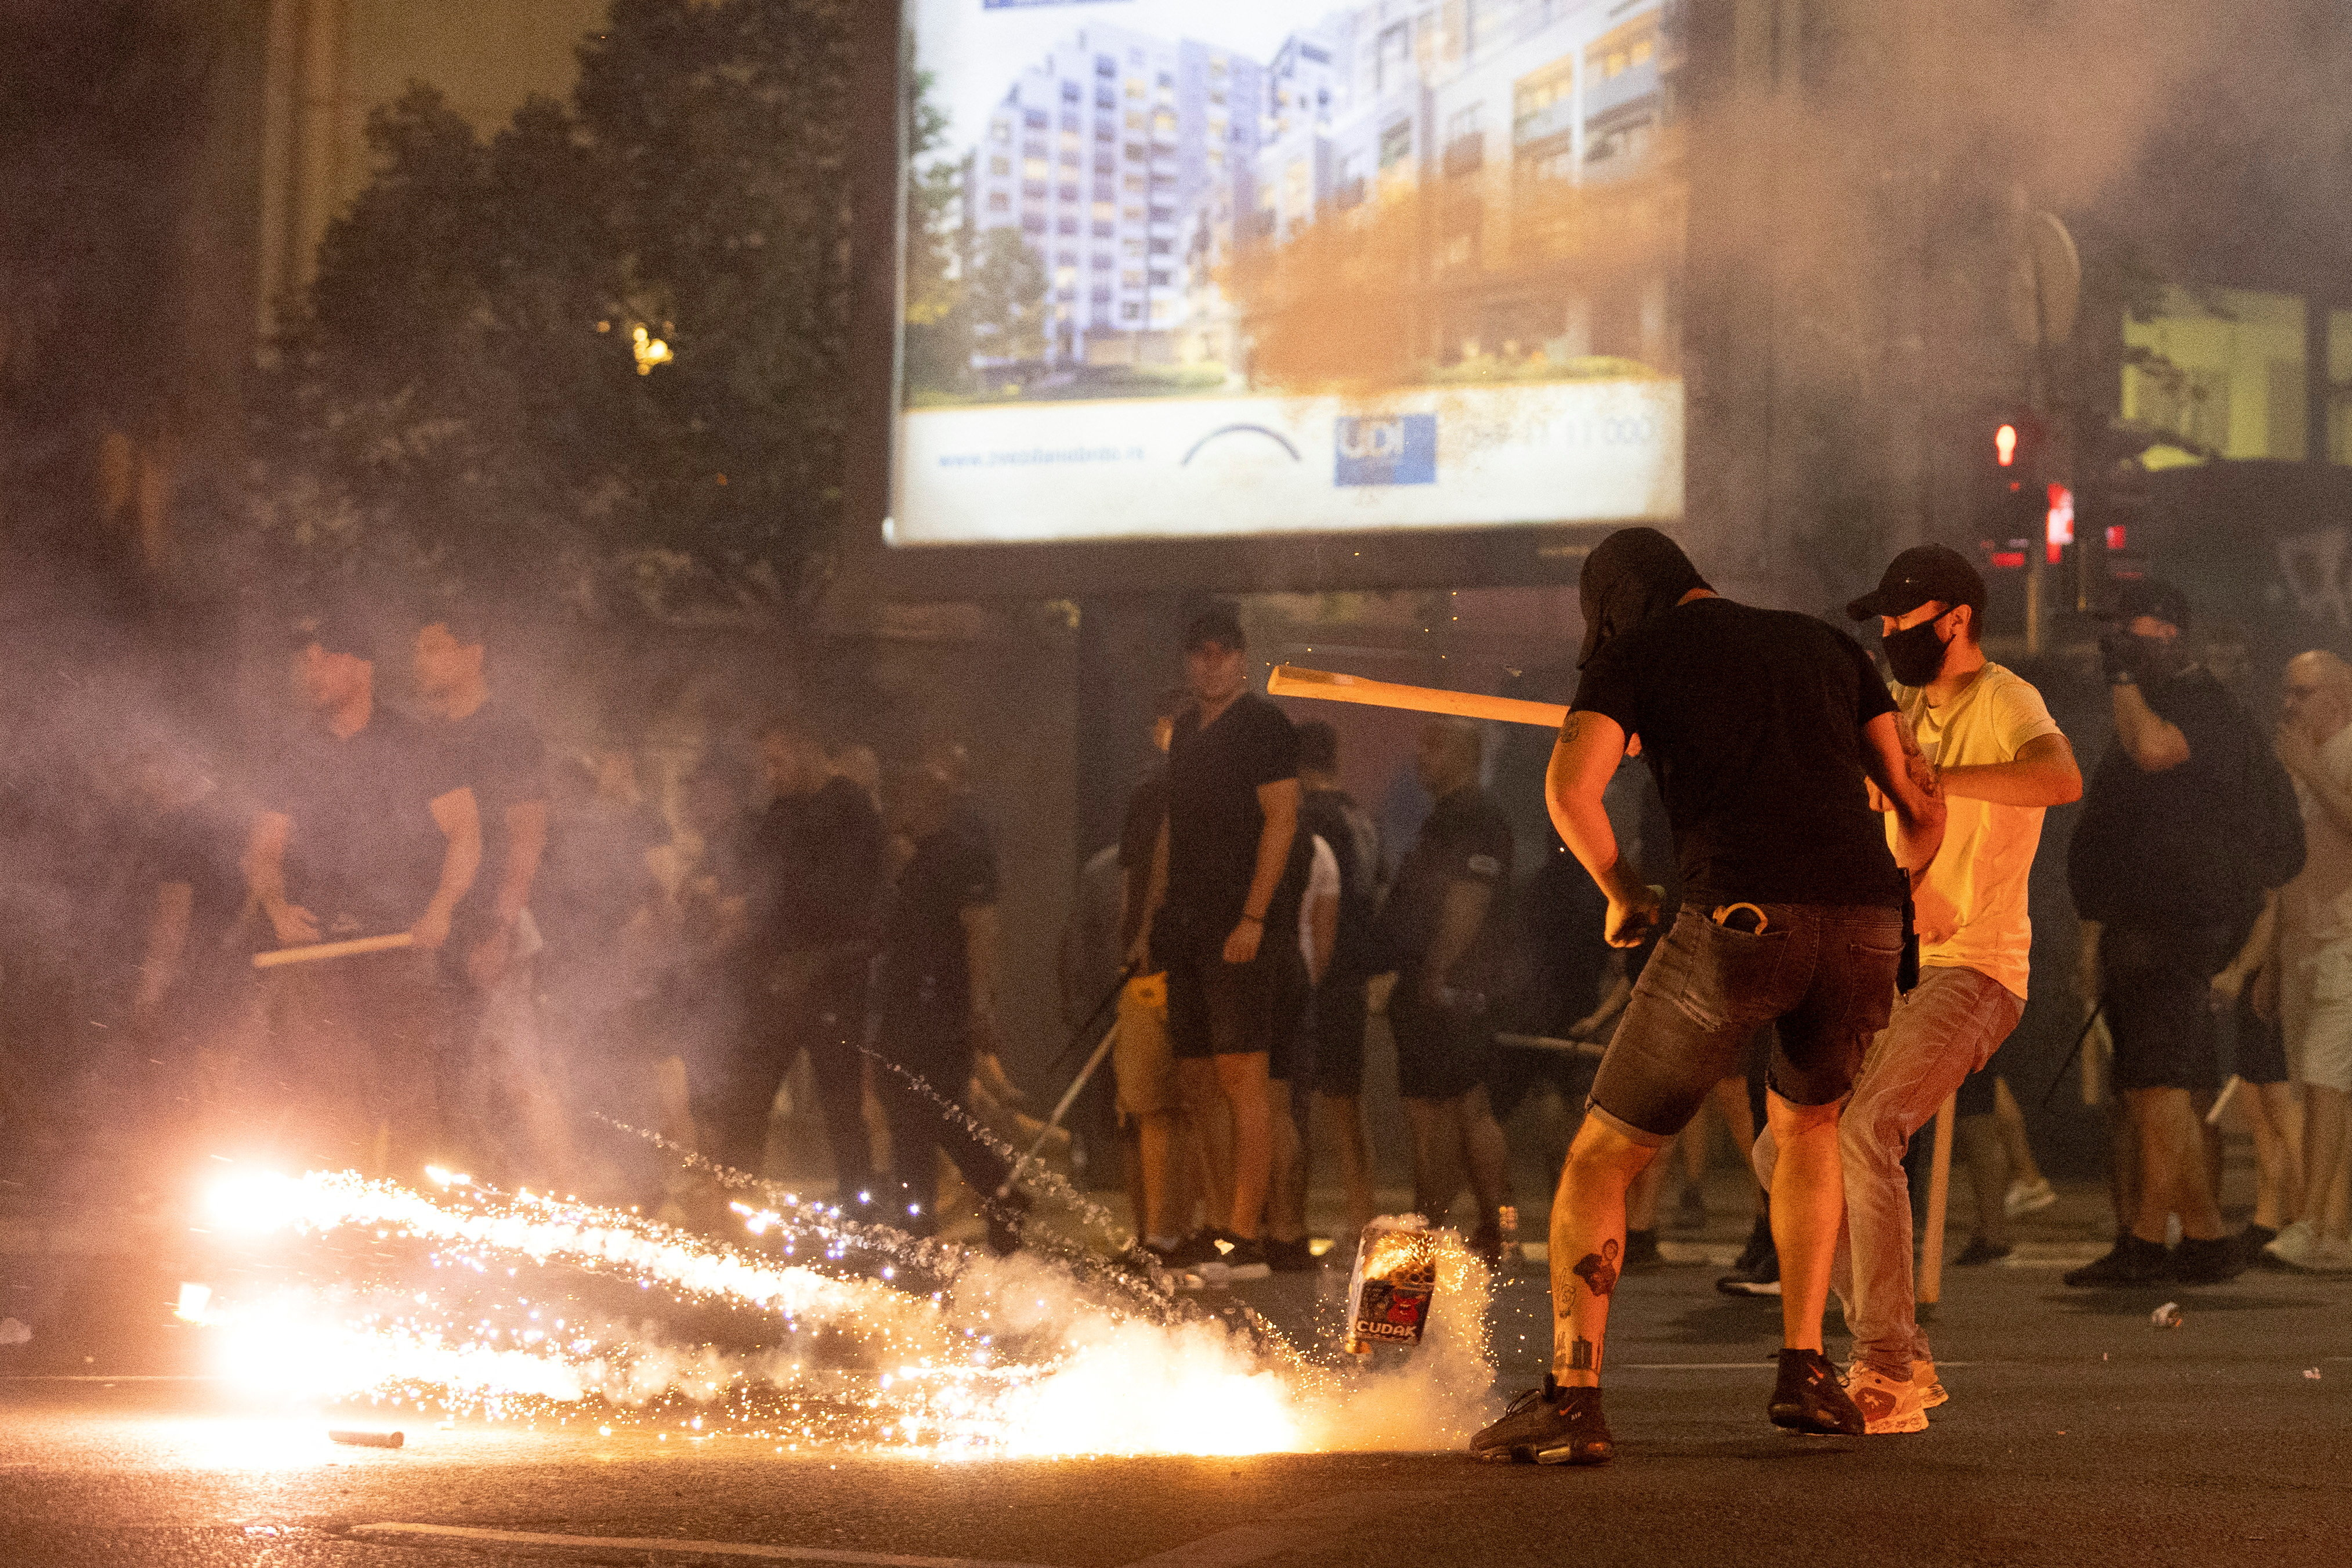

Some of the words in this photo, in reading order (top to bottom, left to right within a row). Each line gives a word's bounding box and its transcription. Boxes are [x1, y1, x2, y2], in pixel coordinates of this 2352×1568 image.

[1337, 420, 1405, 459] UDI
[1357, 1320, 1417, 1337] CUDAK
[1571, 1411, 1582, 1421] AIR
